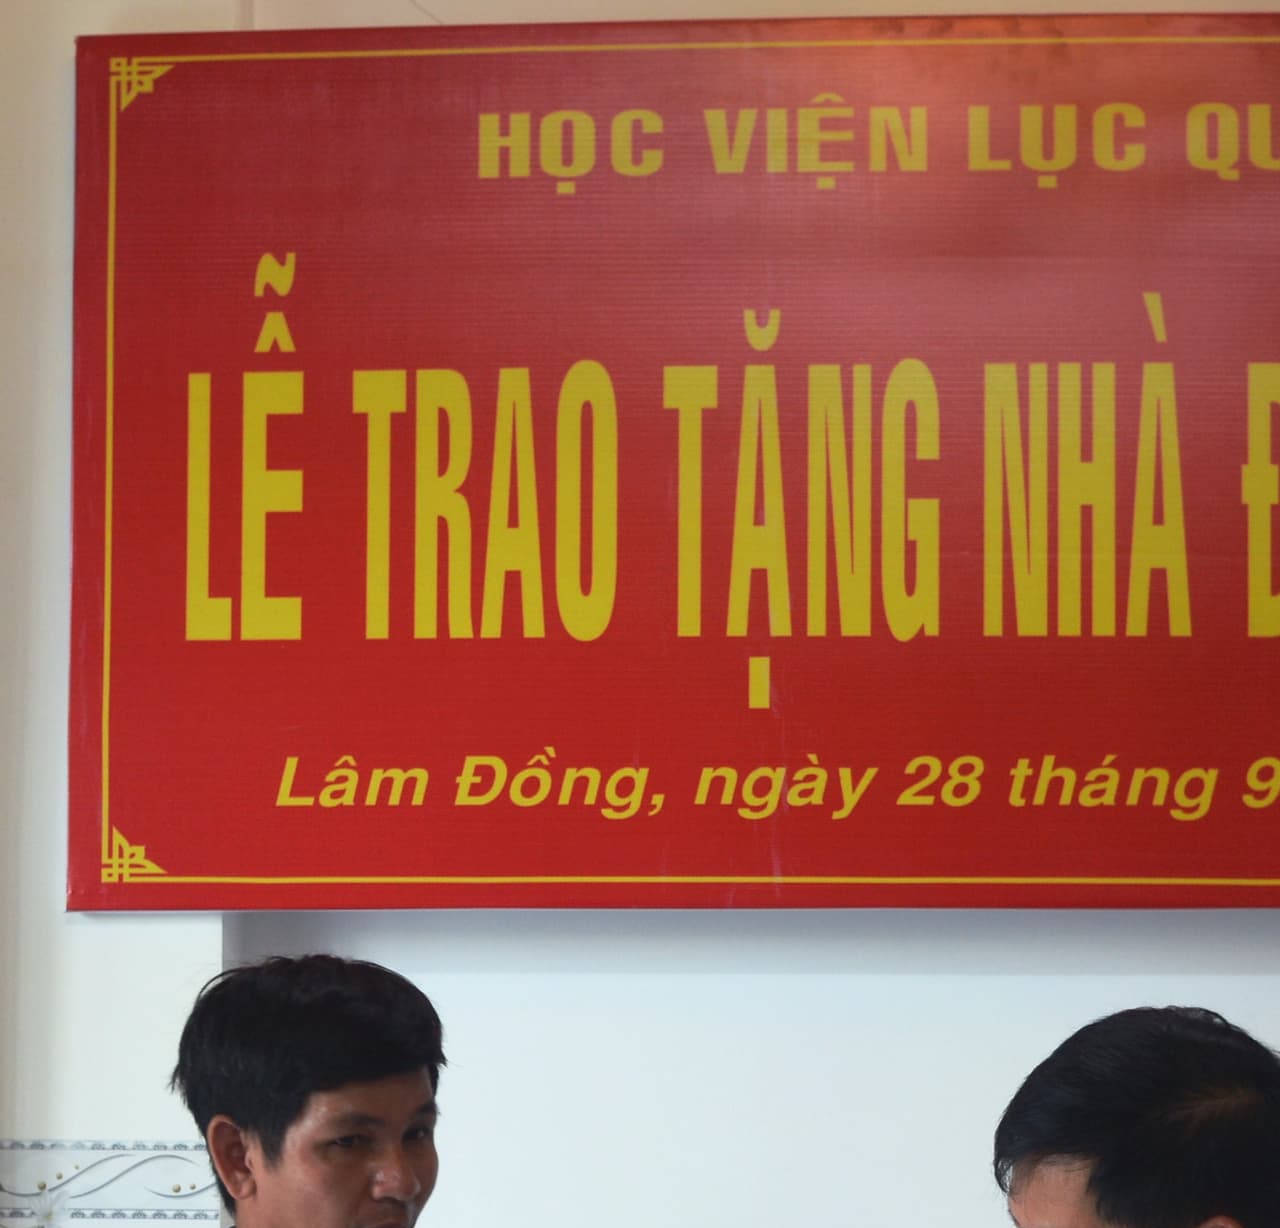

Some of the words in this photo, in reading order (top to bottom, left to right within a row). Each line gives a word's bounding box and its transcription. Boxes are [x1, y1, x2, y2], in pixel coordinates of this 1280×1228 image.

[477, 110, 664, 194] HỌC
[704, 93, 928, 189] VIỆN
[968, 102, 1146, 189] LỤC
[184, 252, 304, 642] LỄ
[352, 358, 620, 642] TRAO
[663, 308, 942, 709] TẶNG
[982, 293, 1193, 639] NHÀ
[275, 755, 429, 807] Lâm
[454, 746, 665, 820] Đồng,
[694, 753, 878, 820] ngày
[896, 755, 985, 807] 28
[1008, 754, 1219, 821] tháng
